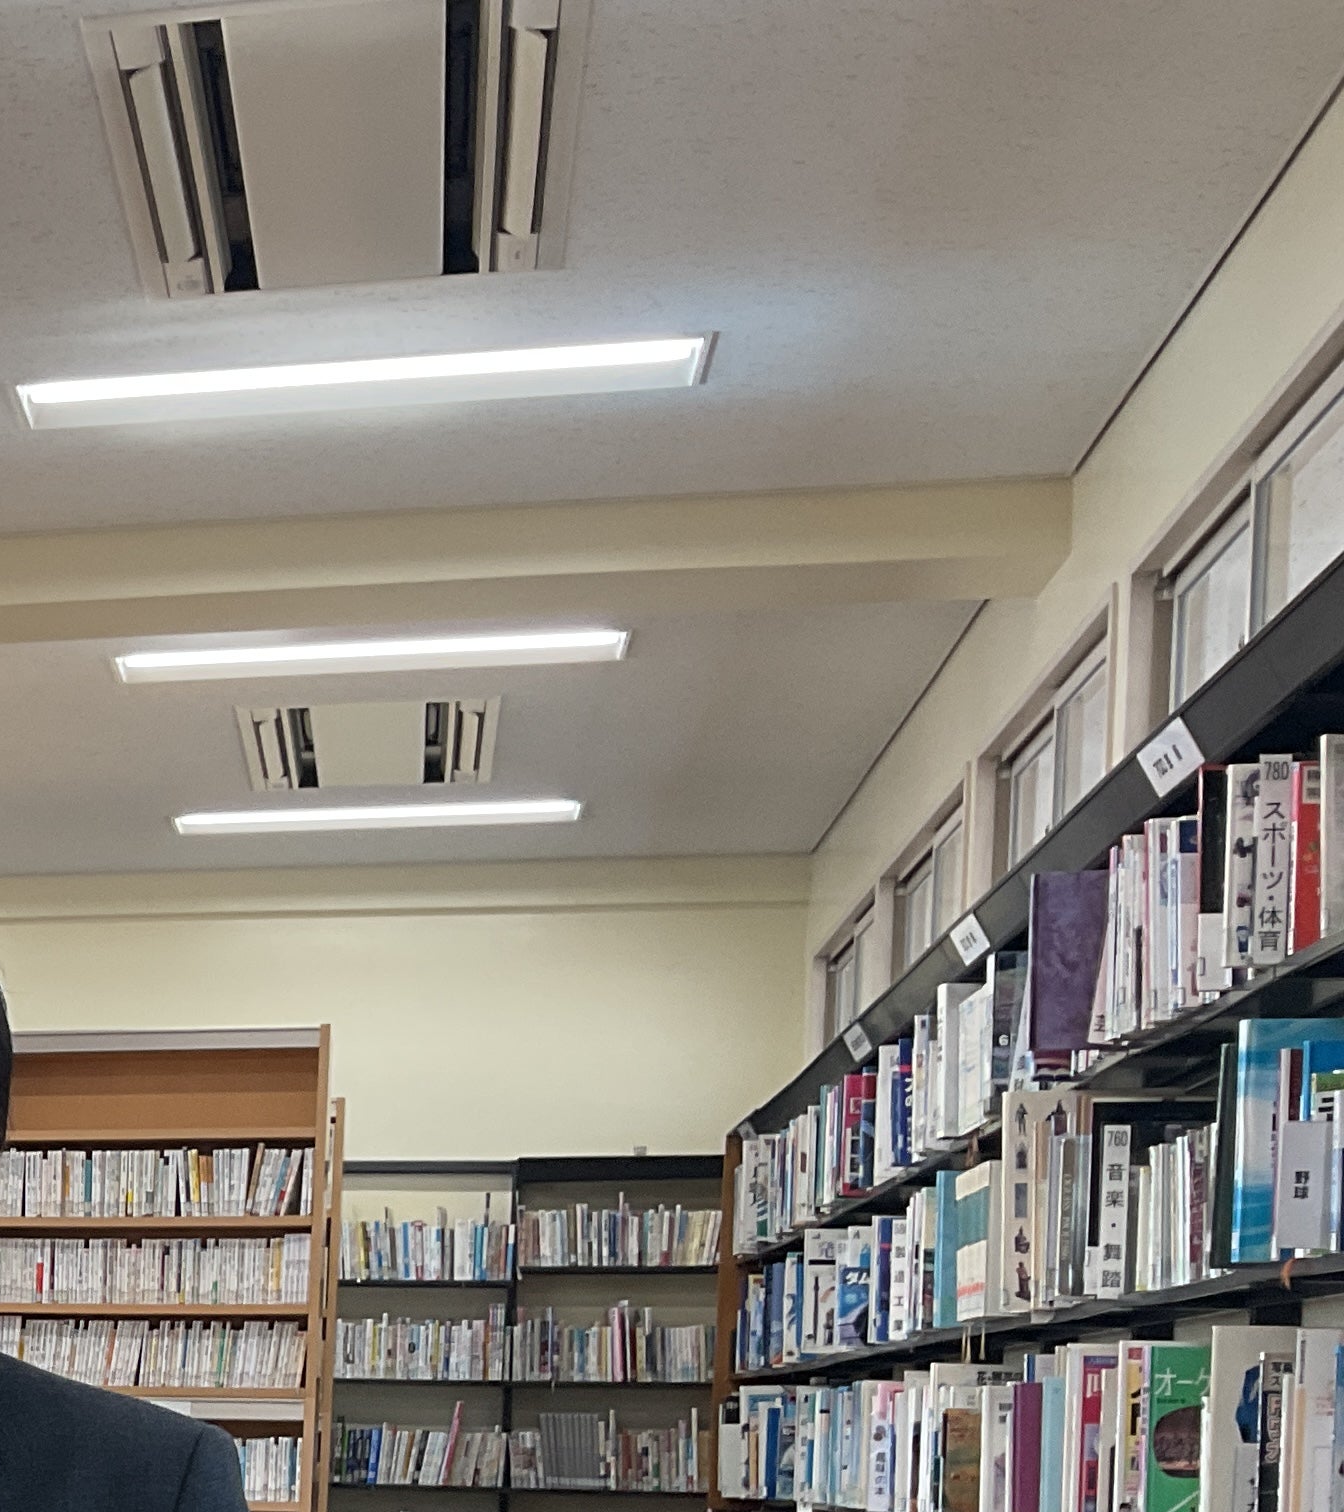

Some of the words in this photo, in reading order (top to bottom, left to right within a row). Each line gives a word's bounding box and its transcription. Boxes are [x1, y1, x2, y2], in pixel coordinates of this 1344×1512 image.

[1265, 761, 1289, 781] 780
[1258, 801, 1287, 951] スポーツ・体育
[1107, 1130, 1128, 1147] 760
[1293, 1170, 1310, 1200] 野球
